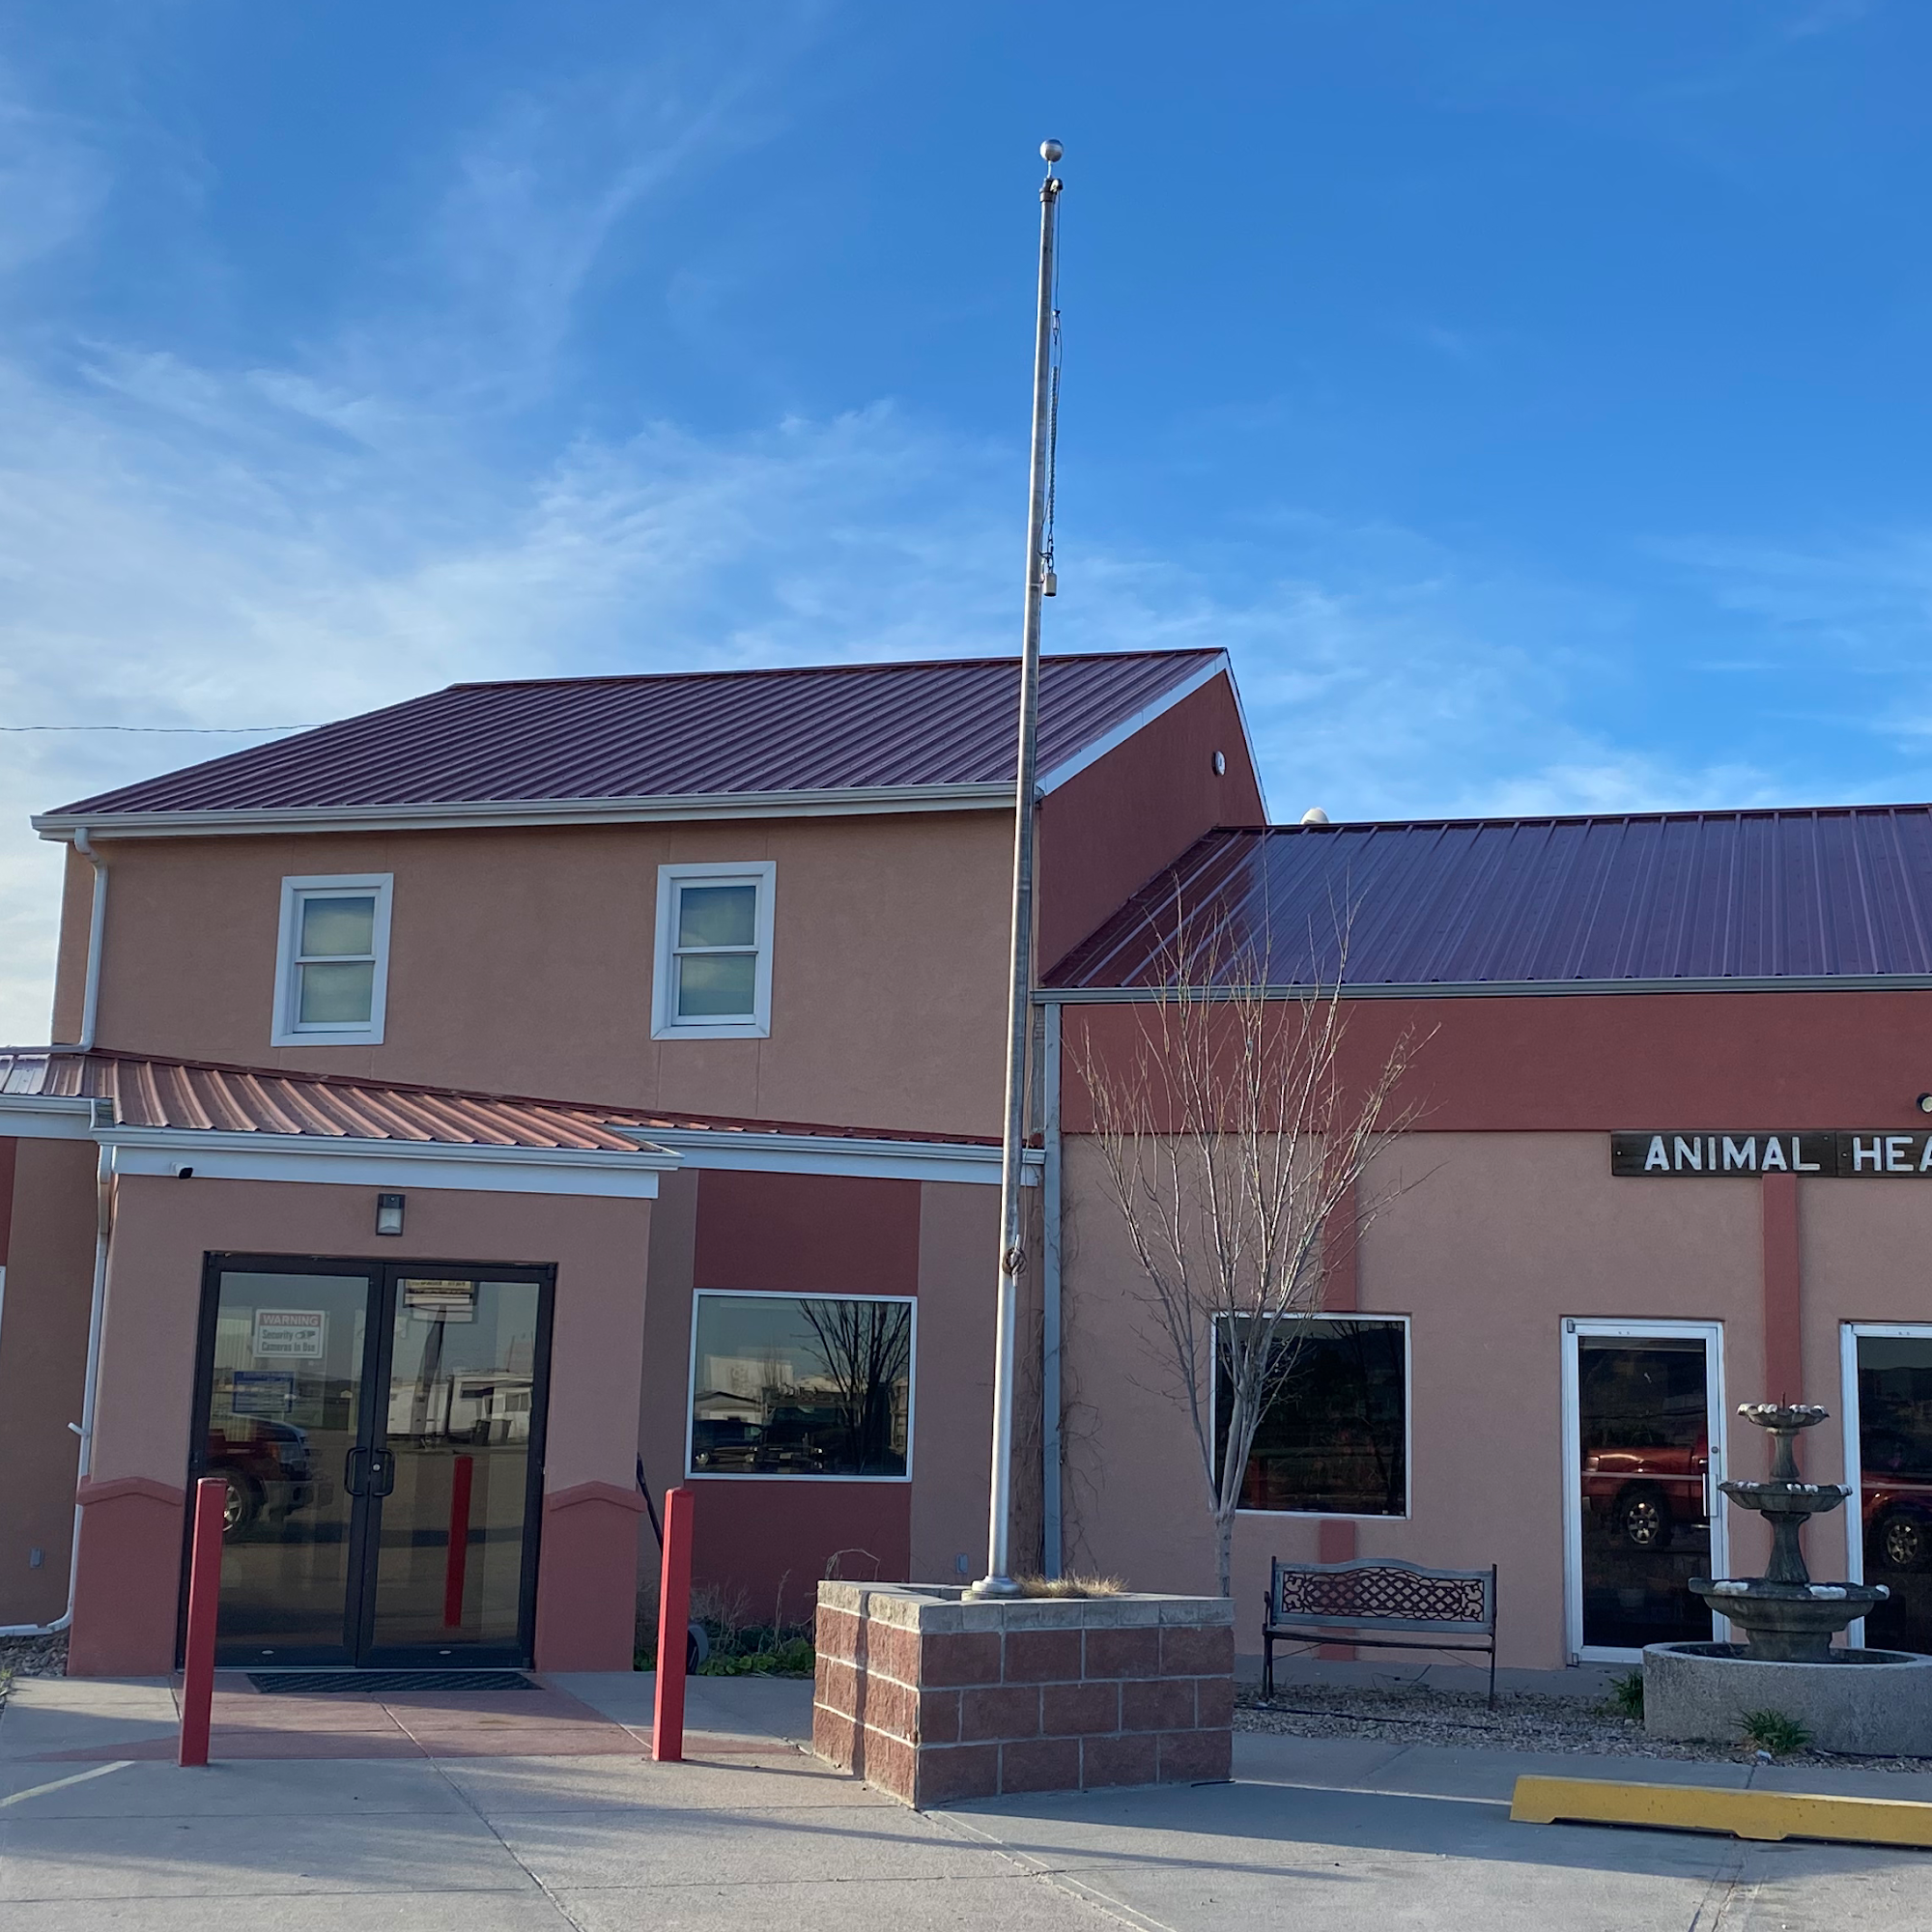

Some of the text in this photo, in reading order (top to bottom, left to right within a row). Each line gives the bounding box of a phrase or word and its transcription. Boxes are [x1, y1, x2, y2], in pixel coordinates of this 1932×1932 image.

[1644, 1135, 1821, 1171] ANIMAL
[262, 1314, 319, 1326] WARNING
[262, 1329, 294, 1342] Security
[262, 1341, 292, 1351] Cameras
[302, 1342, 316, 1352] Use
